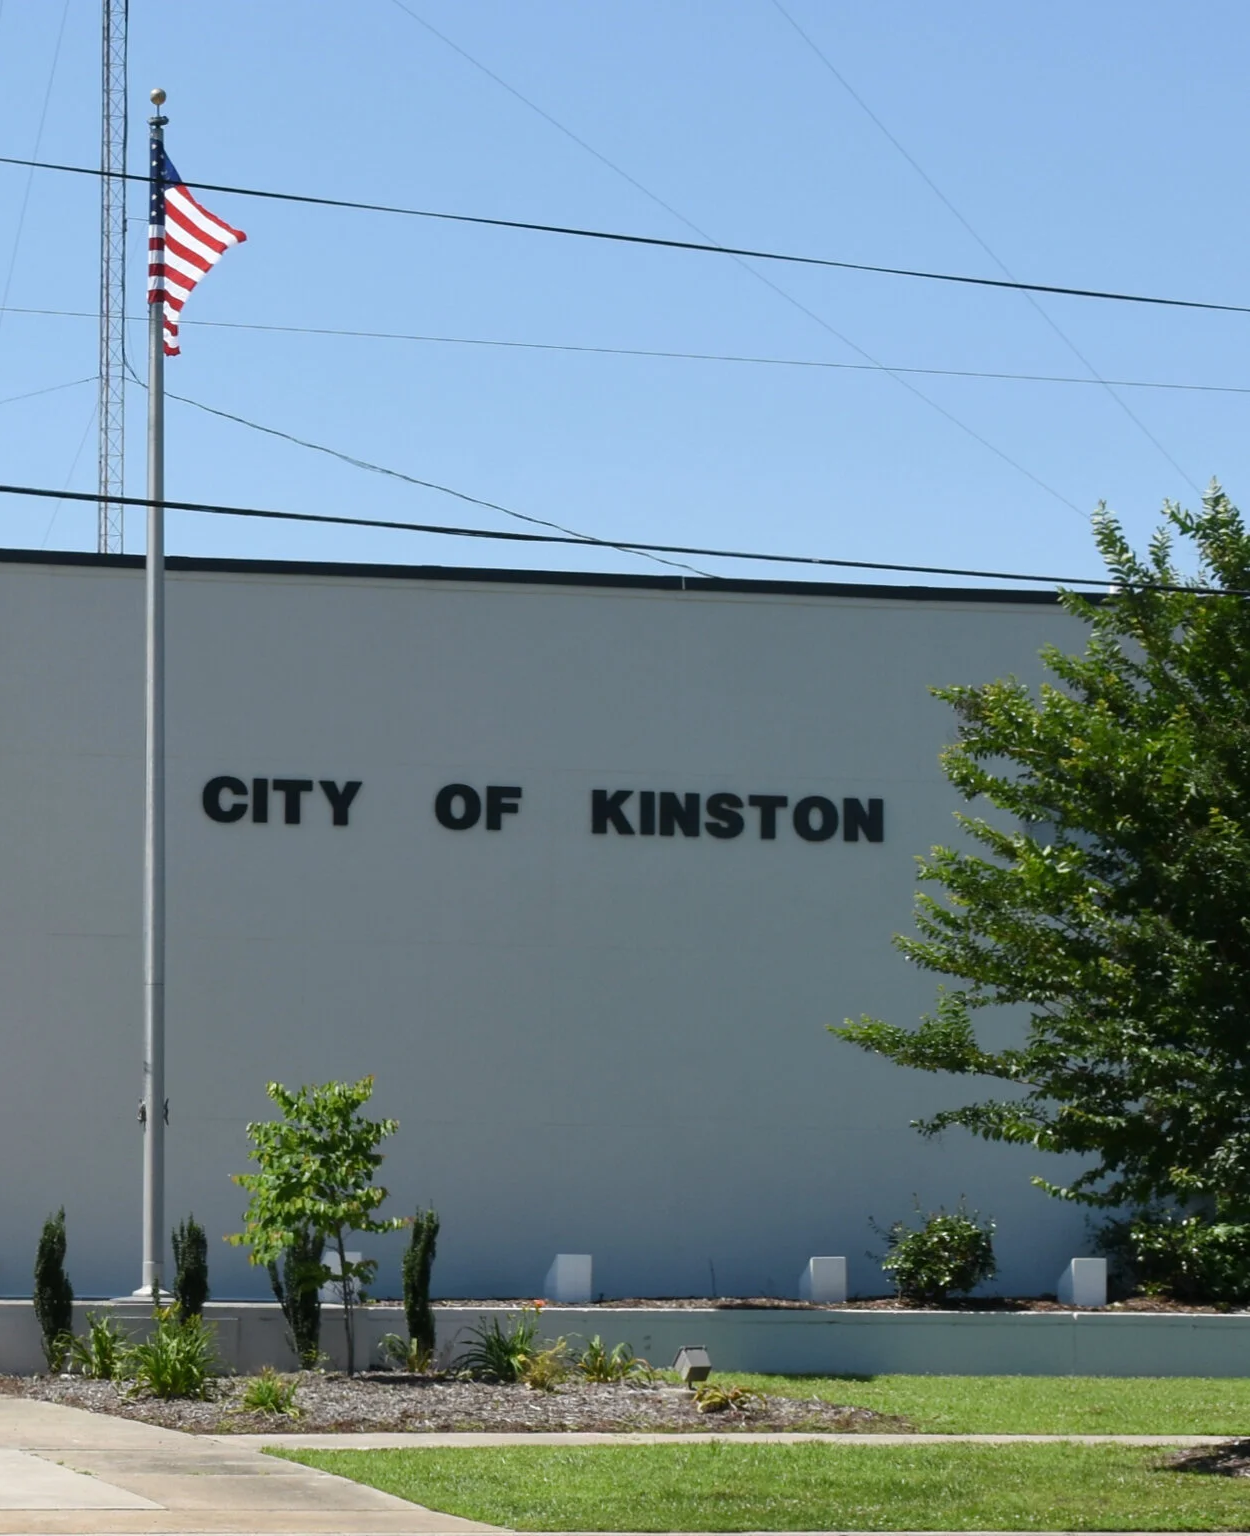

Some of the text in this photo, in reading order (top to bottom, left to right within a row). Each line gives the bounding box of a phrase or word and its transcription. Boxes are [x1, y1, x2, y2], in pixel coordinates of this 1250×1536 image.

[202, 775, 885, 843] CITY OF KINSTON
